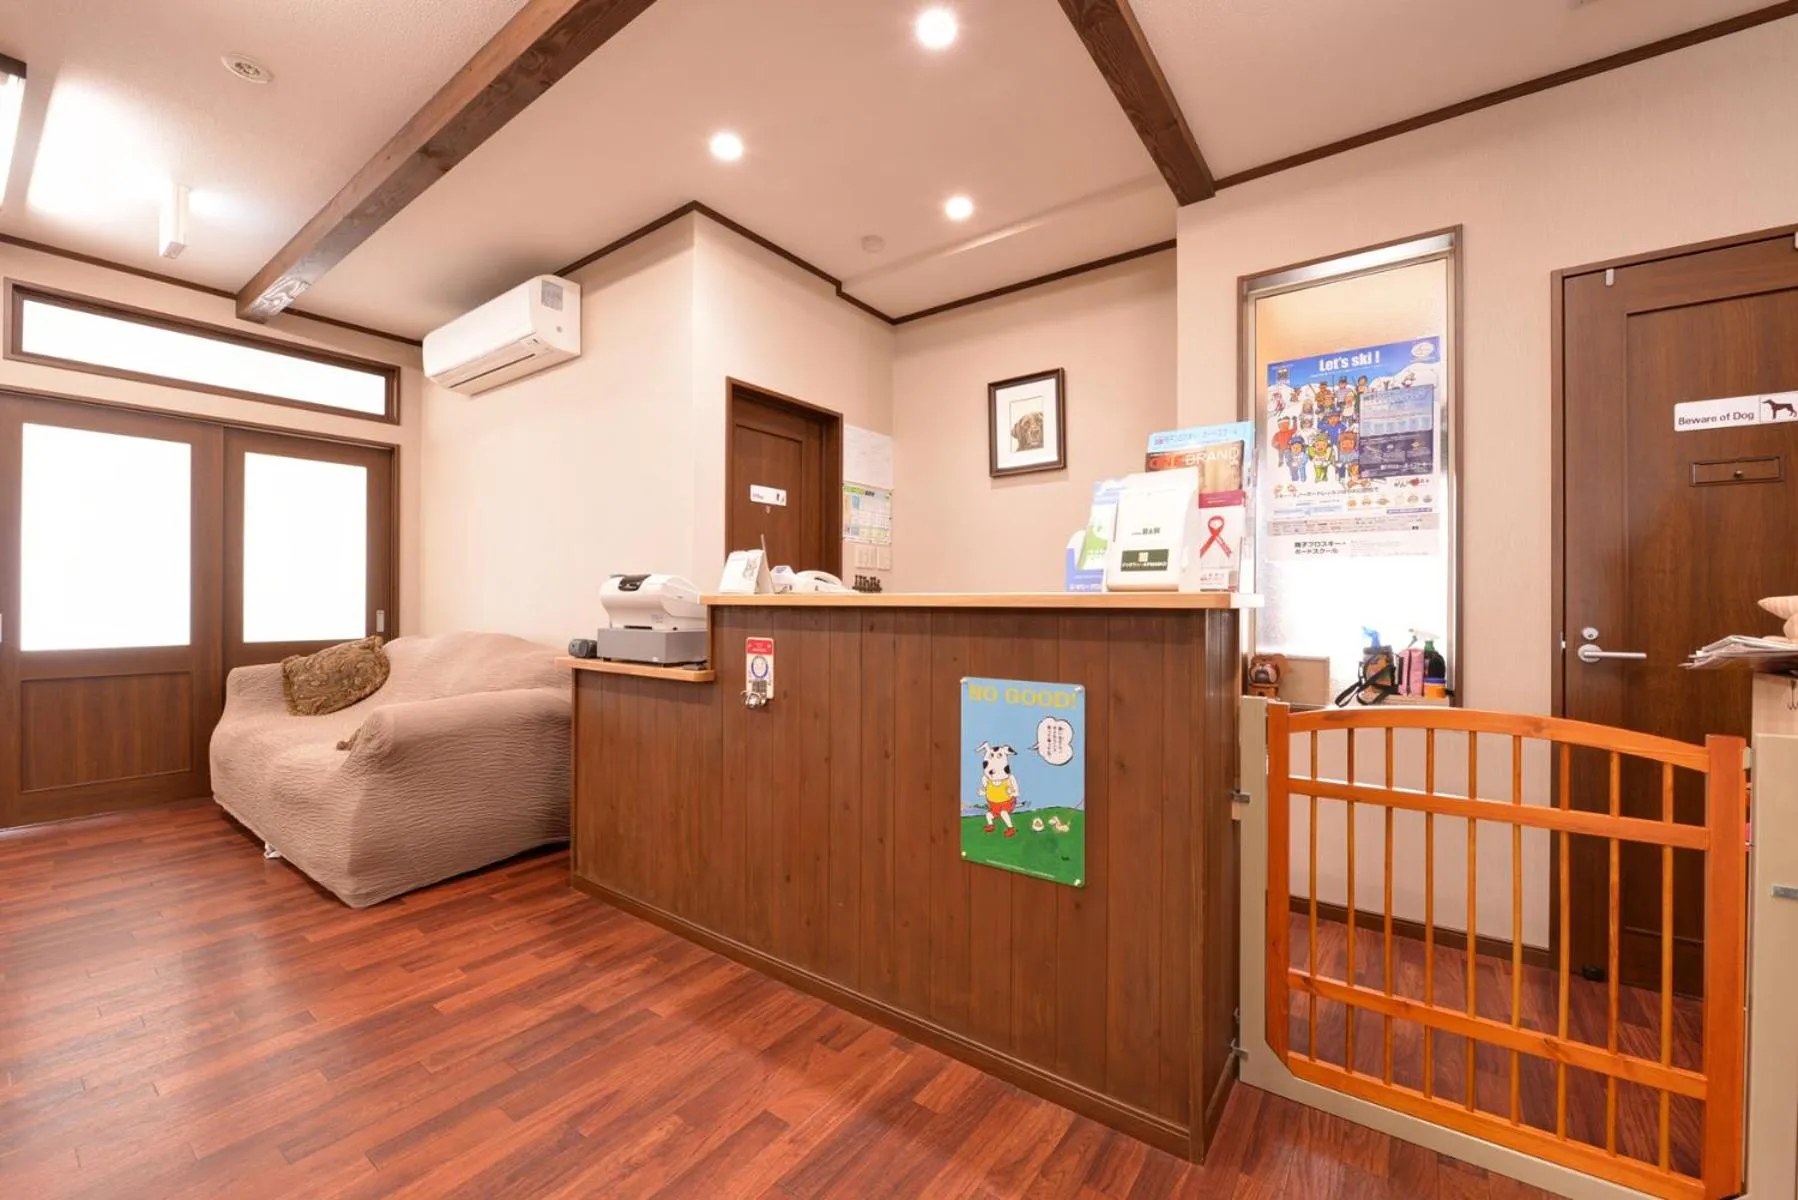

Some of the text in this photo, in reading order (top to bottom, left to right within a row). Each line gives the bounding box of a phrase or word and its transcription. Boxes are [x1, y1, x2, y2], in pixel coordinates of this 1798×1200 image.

[1319, 355, 1348, 373] Let's
[1678, 412, 1755, 426] Beware of Dog
[1184, 446, 1239, 466] BRAND
[968, 684, 1077, 710] NO GOOD!
